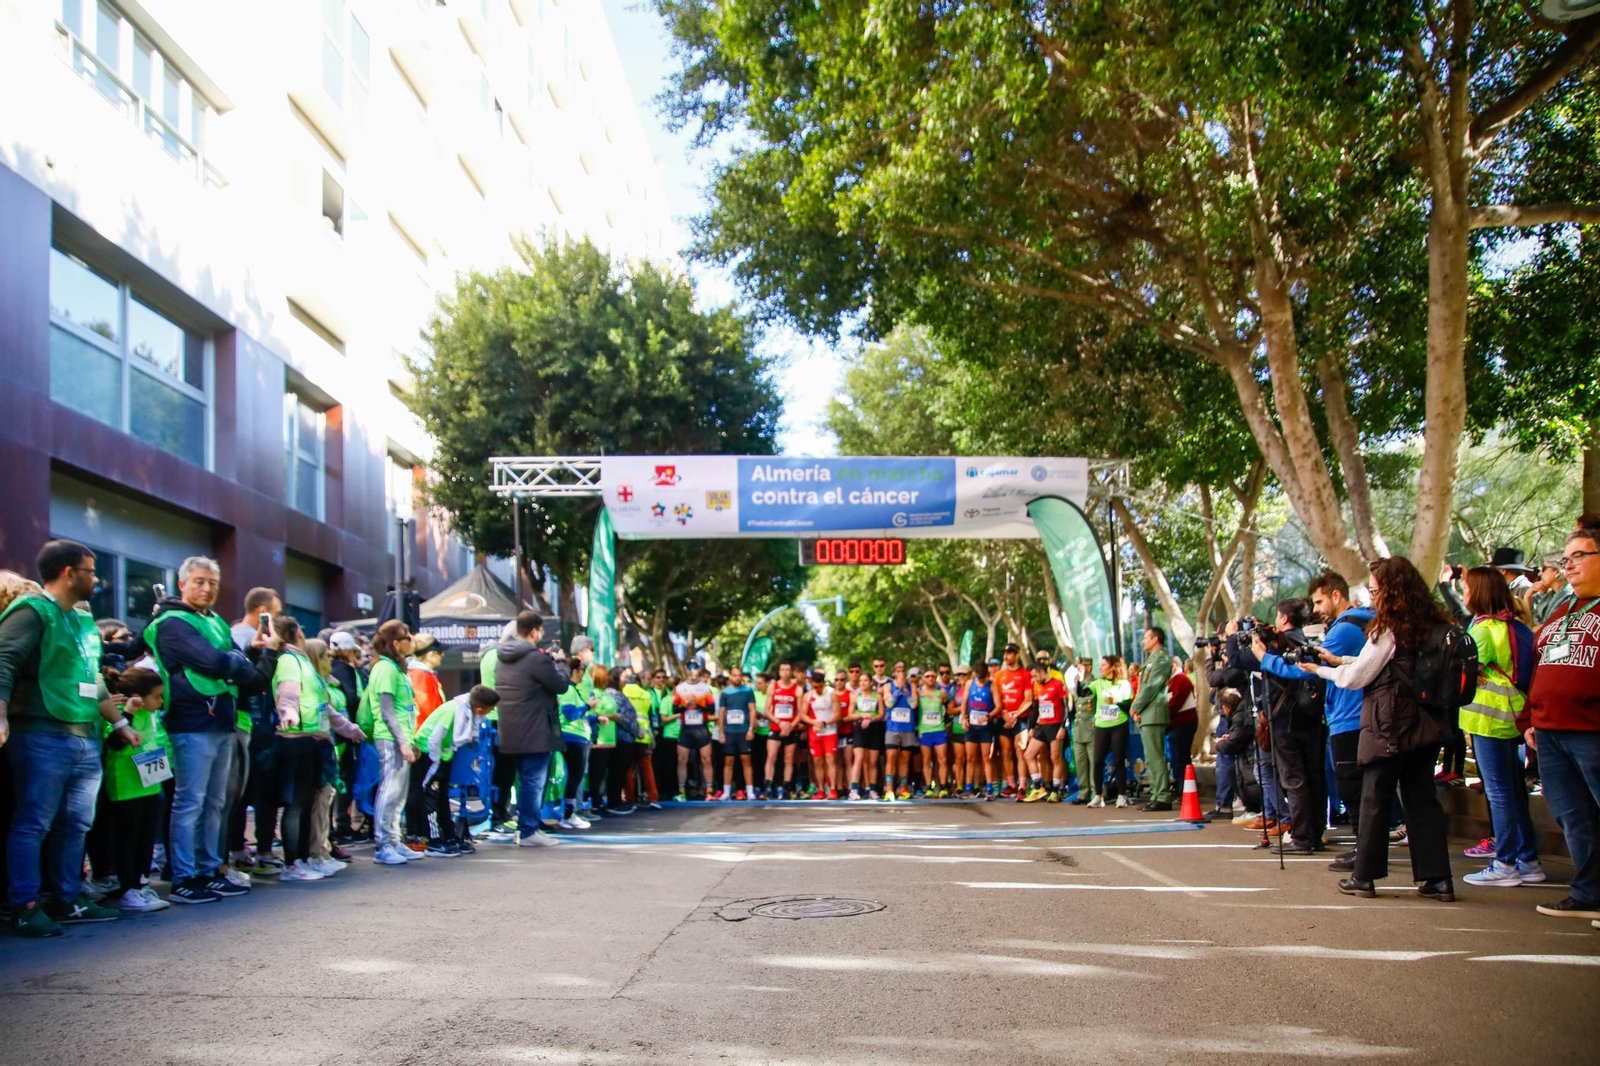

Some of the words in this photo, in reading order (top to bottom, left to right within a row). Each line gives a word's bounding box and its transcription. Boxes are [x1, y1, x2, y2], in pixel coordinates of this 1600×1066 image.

[751, 463, 831, 482] Almería
[837, 470, 861, 481] en
[868, 466, 944, 482] marcha
[751, 488, 818, 505] contra
[823, 487, 843, 504] el
[849, 487, 919, 505] cáncer
[144, 758, 165, 774] 778
